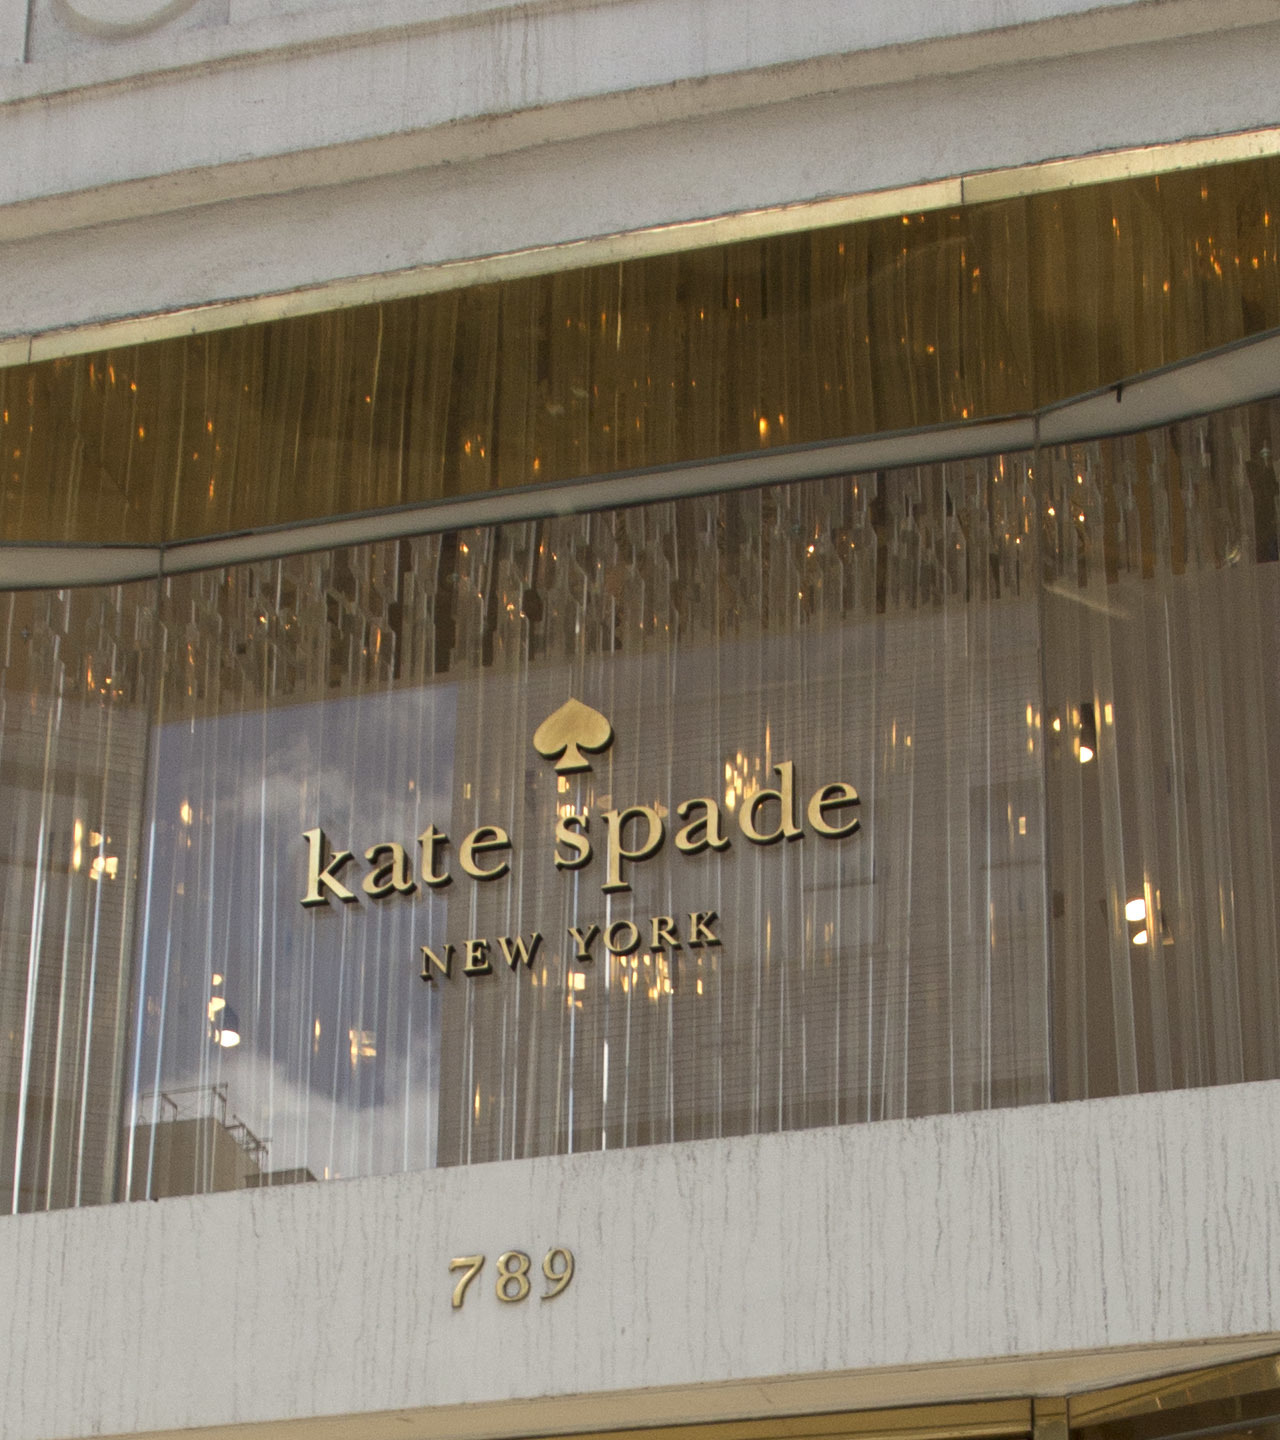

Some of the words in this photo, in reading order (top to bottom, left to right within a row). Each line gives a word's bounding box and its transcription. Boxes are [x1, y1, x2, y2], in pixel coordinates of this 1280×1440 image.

[300, 822, 512, 908] kate
[554, 761, 861, 893] spade
[419, 932, 542, 981] NEW
[568, 911, 722, 961] YORK
[448, 1247, 575, 1308] 789
